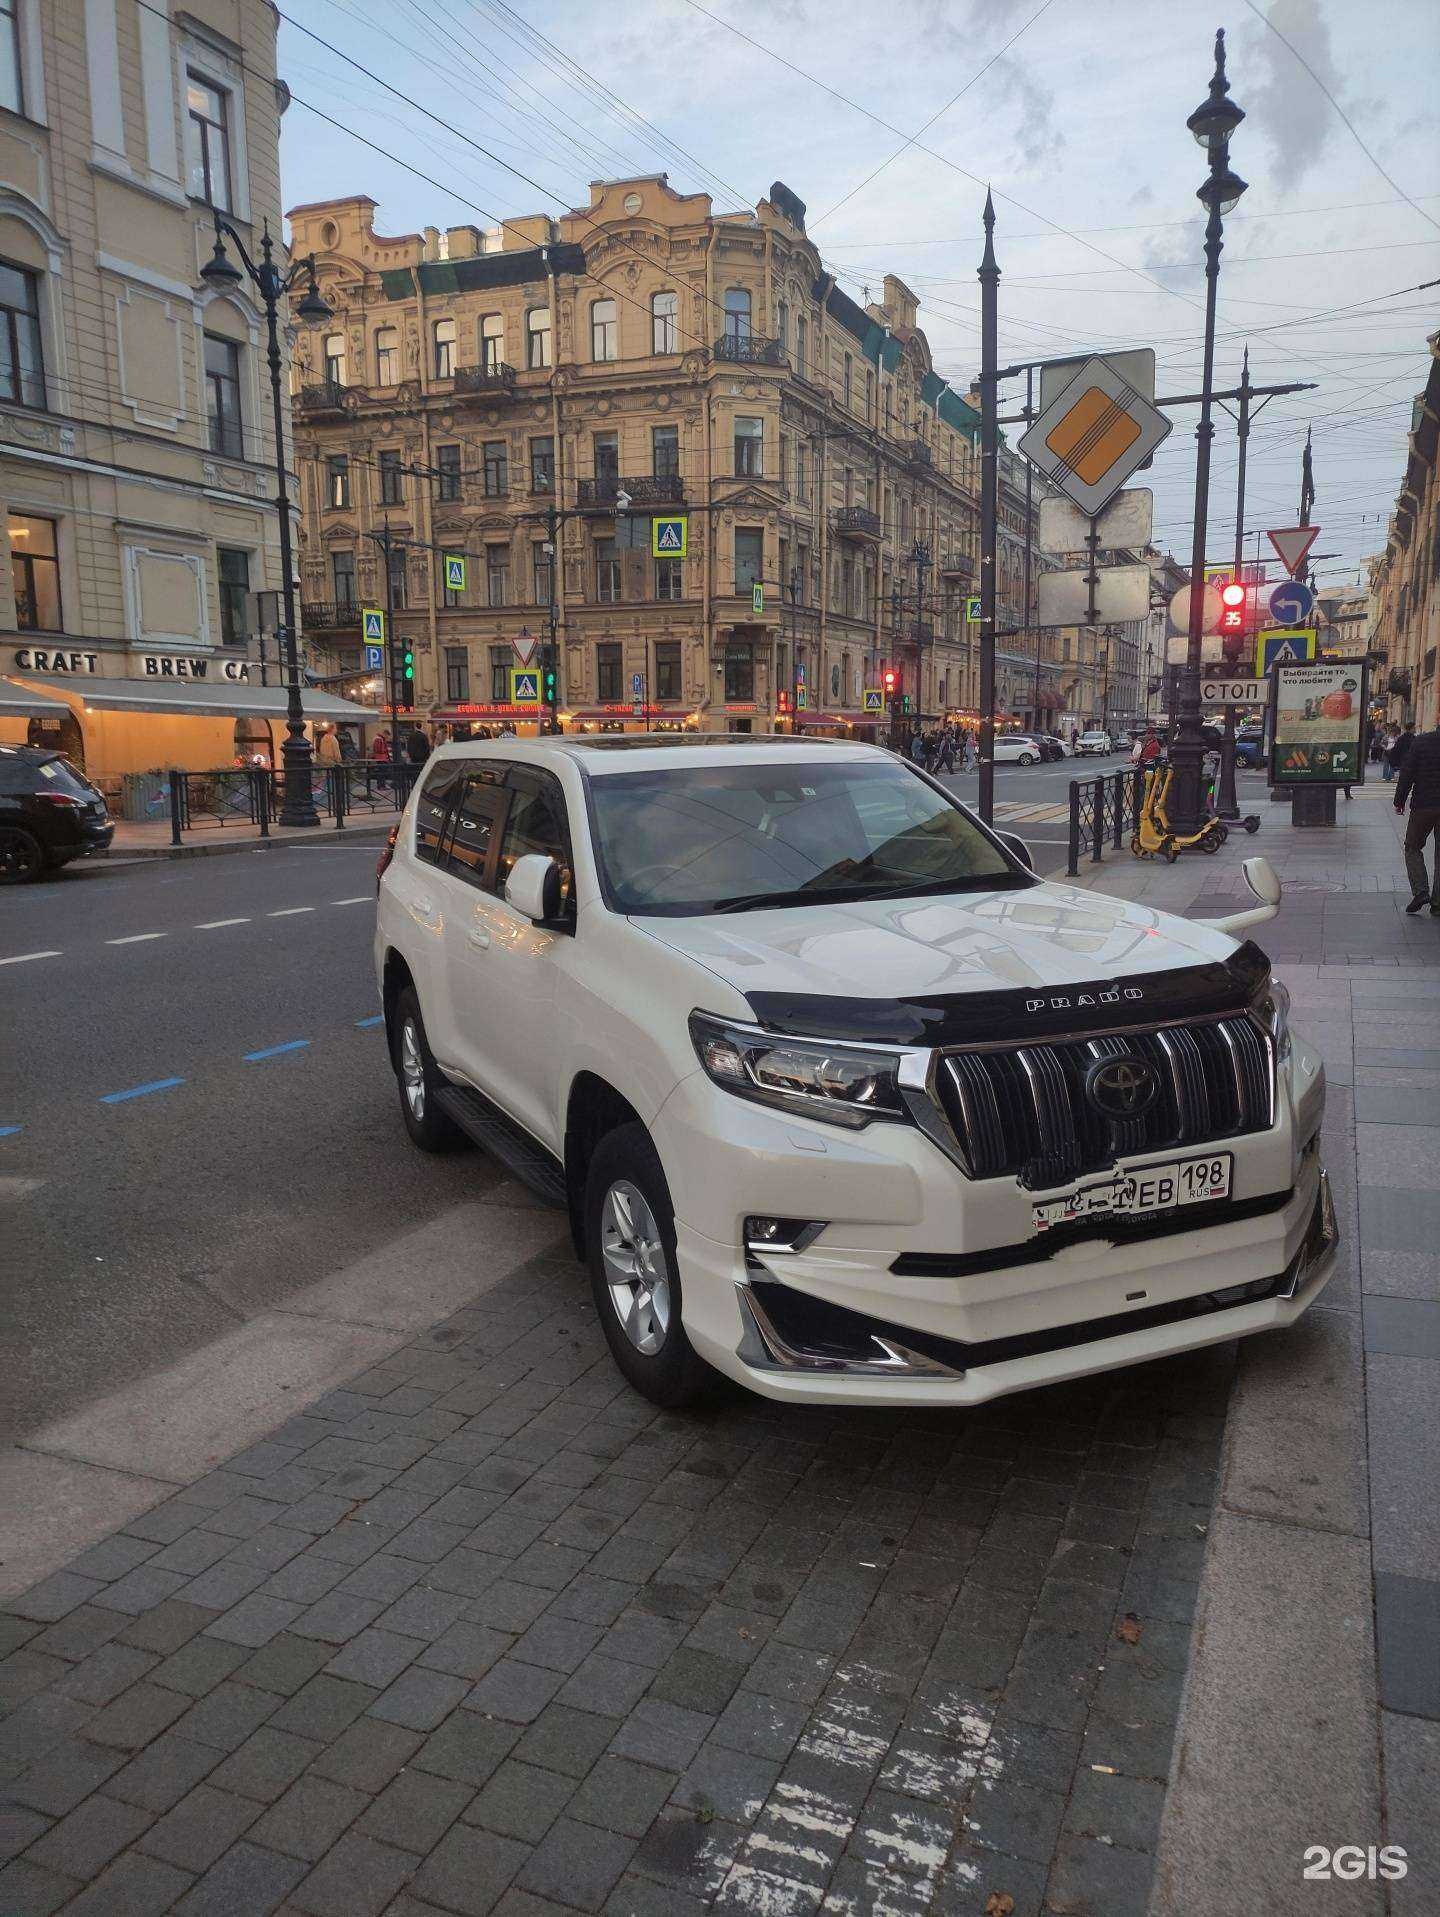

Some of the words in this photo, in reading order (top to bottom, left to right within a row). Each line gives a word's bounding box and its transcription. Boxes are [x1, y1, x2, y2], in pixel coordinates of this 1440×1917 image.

[1225, 611, 1241, 626] 35
[15, 649, 97, 673] CRAFT
[145, 657, 208, 678] BREW
[1283, 669, 1333, 677] Выбирайте
[1203, 683, 1258, 699] СТОП
[1026, 988, 1143, 1012] PRADO
[1182, 1160, 1223, 1190] 198
[1189, 1187, 1210, 1198] RUS
